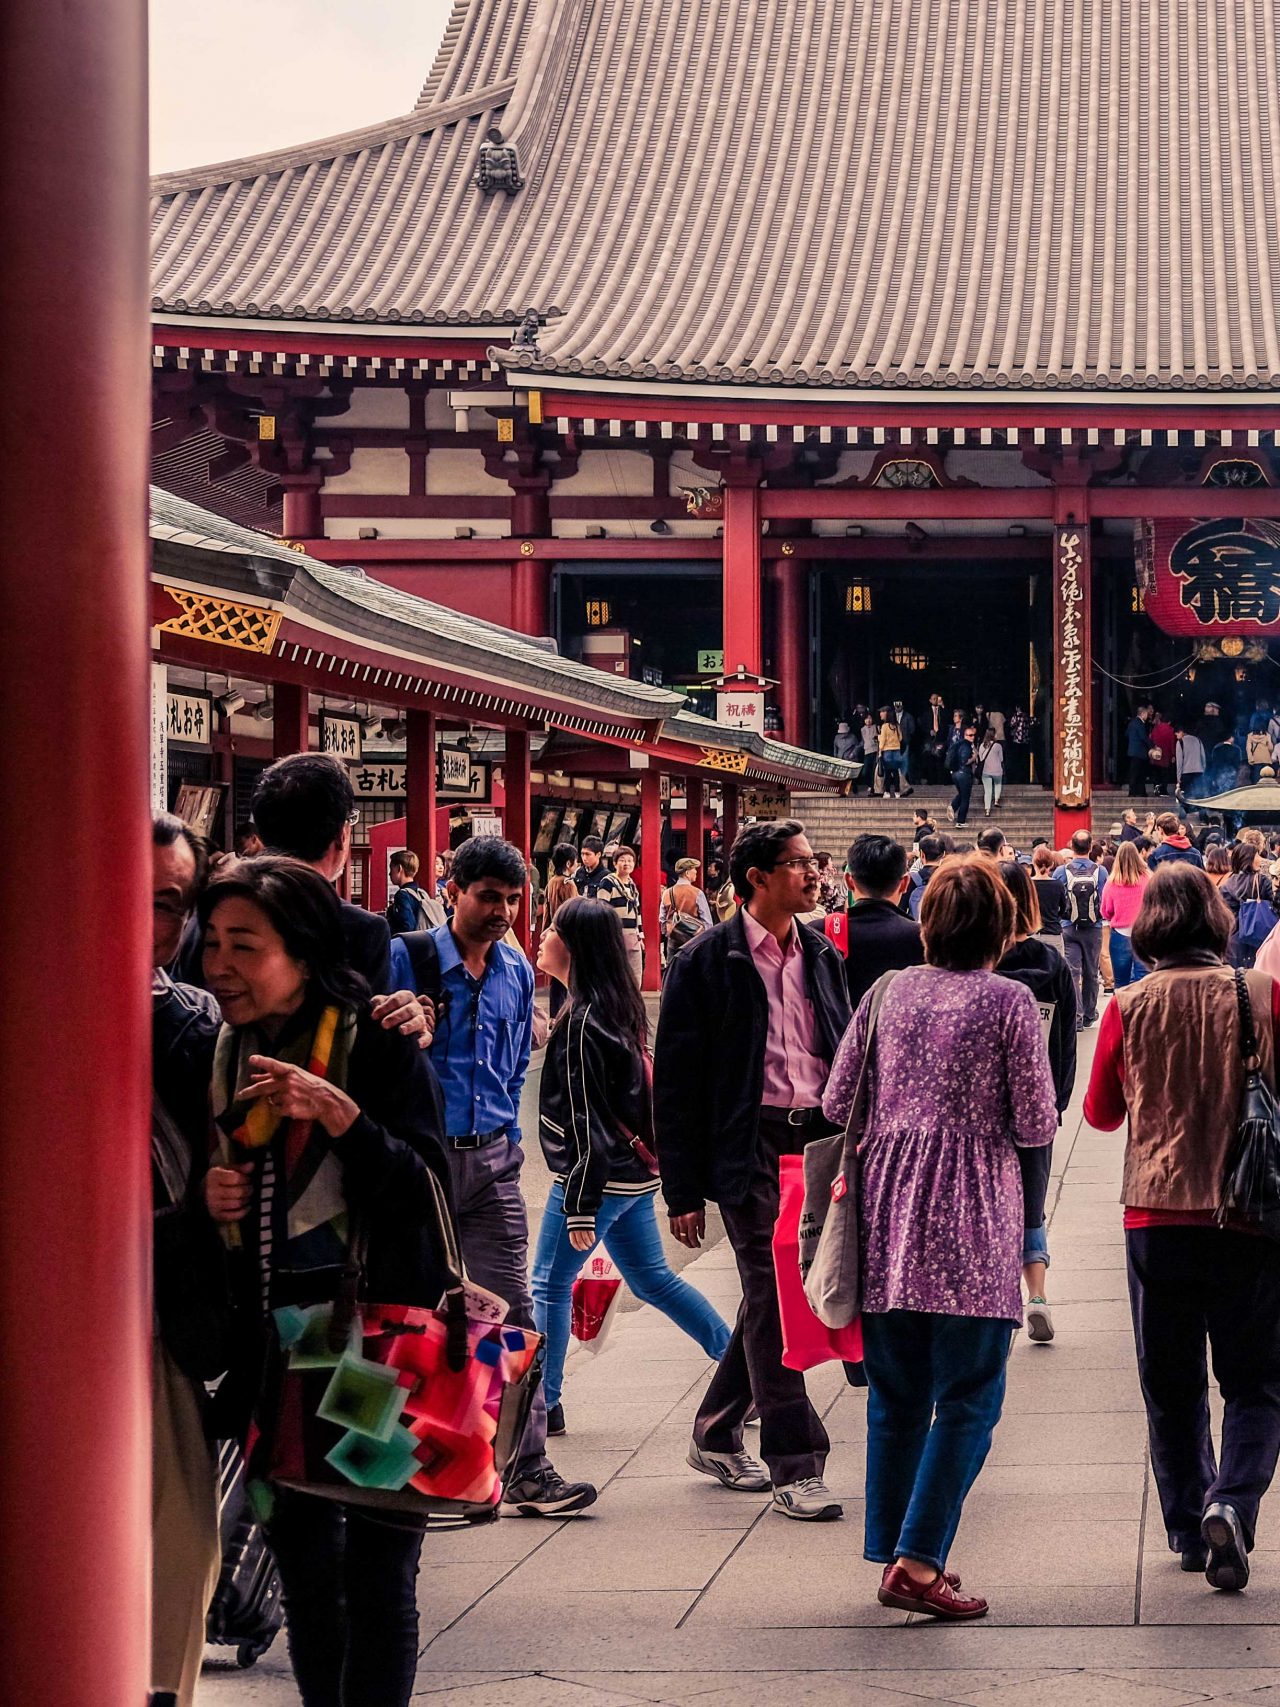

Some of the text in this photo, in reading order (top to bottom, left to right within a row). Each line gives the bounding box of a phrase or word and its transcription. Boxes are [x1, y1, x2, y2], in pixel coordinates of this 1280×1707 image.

[703, 654, 723, 669] お
[166, 698, 204, 740] 札お守
[833, 917, 841, 935] EOS
